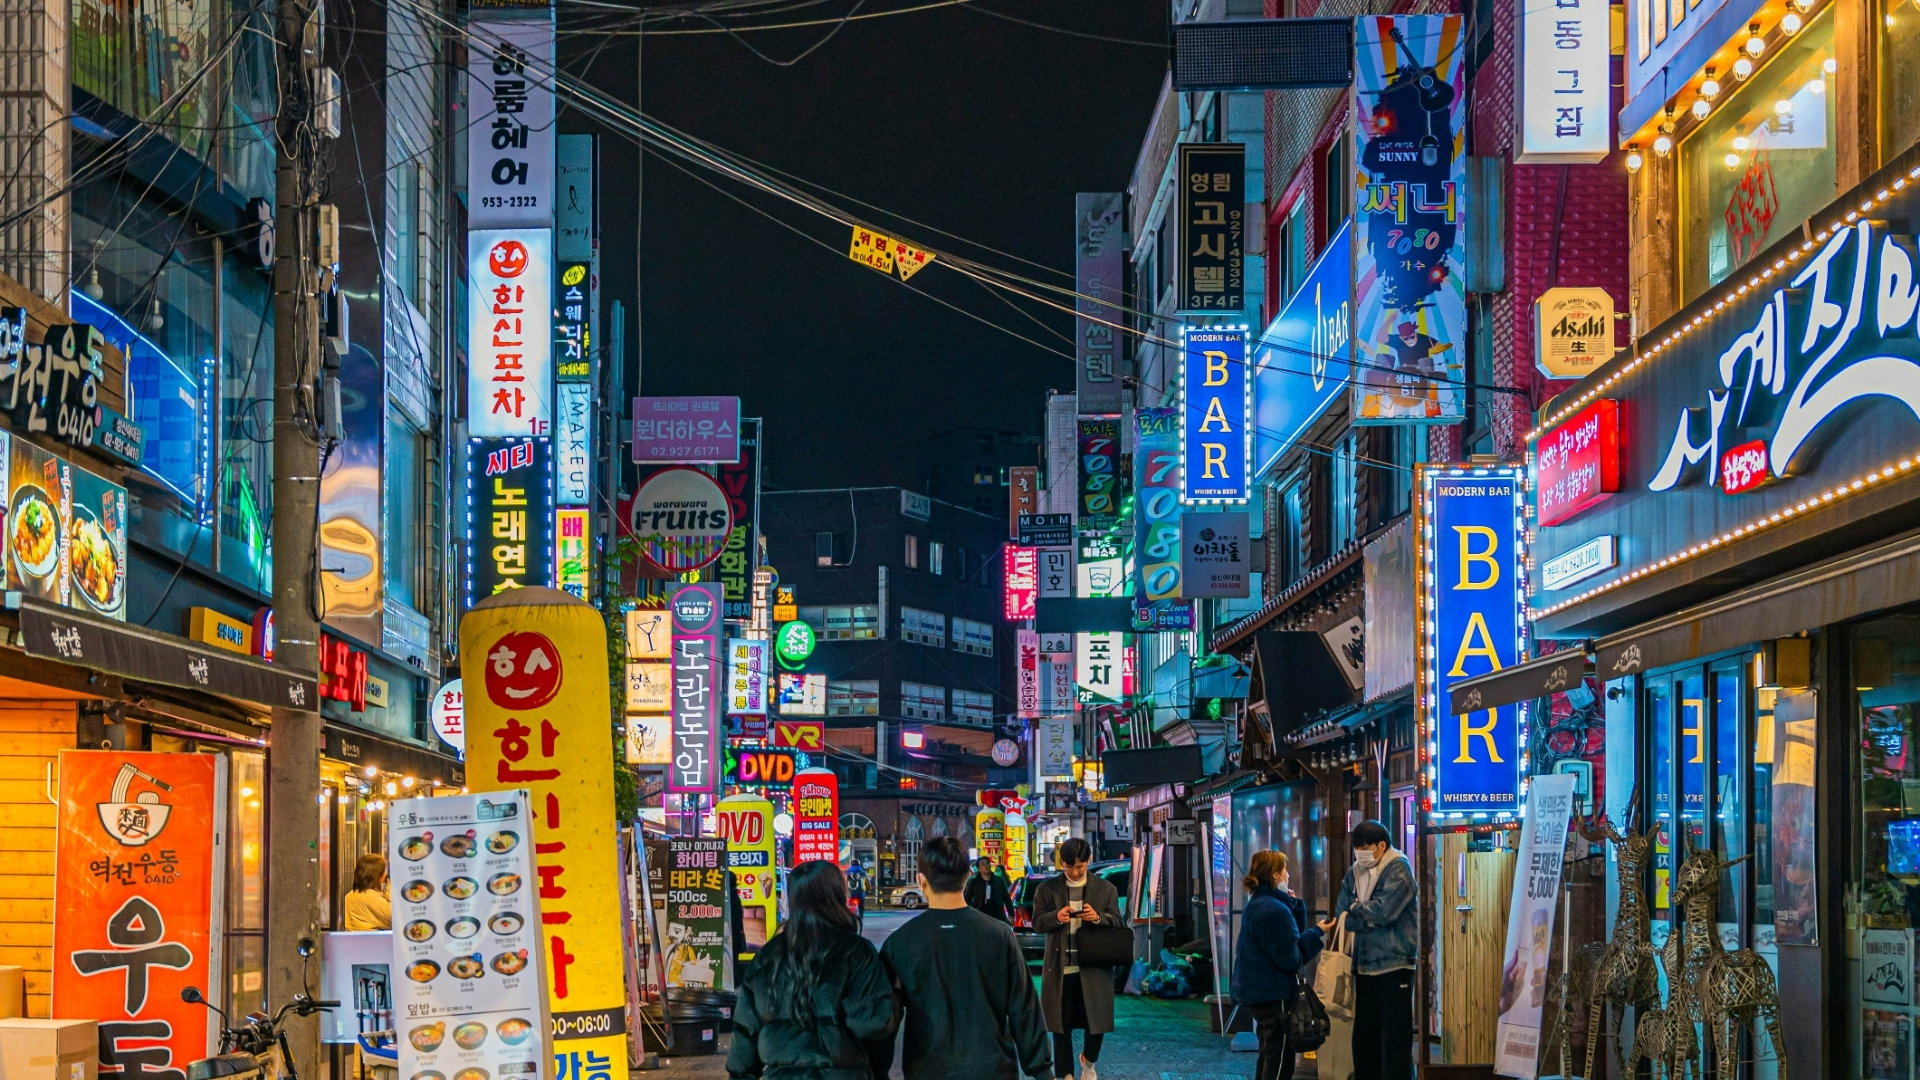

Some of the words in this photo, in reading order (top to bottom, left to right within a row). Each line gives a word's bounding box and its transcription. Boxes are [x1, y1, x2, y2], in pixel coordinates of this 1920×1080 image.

[1379, 152, 1418, 162] SUNNY
[1191, 173, 1231, 193] 영림
[482, 196, 537, 207] 953-2322
[1362, 181, 1457, 224] 써니
[1192, 201, 1226, 292] 고시텔
[1387, 229, 1440, 255] 7080
[565, 286, 583, 359] 스웨디시
[1328, 300, 1349, 360] BAR
[1551, 315, 1605, 337] Asahi
[1190, 334, 1223, 342] MODERN
[1225, 334, 1241, 342] BAR
[1571, 341, 1586, 352] 生
[492, 284, 526, 418] 한신포차
[1401, 385, 1416, 396] B1
[57, 402, 94, 447] 0410
[1198, 350, 1233, 479] BAR
[528, 417, 549, 435] 1F
[637, 419, 734, 440] 원더하우스
[486, 442, 534, 476] 시티
[651, 446, 719, 456] 02.927.6171
[1086, 439, 1113, 511] 7080
[1439, 486, 1485, 496] MODERN
[1489, 486, 1511, 496] BAR
[653, 501, 708, 509] warawara
[635, 509, 727, 530] Fruits
[1146, 456, 1180, 595] 7080
[1021, 535, 1031, 544] 4F
[720, 522, 752, 600] 영화관
[1193, 542, 1241, 562] 이차돌
[1017, 550, 1034, 589] BAR
[778, 593, 793, 604] 24
[1046, 640, 1066, 651] 2층
[1447, 526, 1504, 763] BAR
[735, 645, 749, 710] 세계주류
[748, 645, 763, 710] 아이스크림
[1080, 691, 1094, 702] 2F
[674, 639, 710, 786] 도란돈암
[779, 724, 820, 748] VR
[740, 752, 794, 782] DVD
[800, 783, 832, 798] 24hour
[1443, 793, 1480, 802] WHISKY
[1490, 793, 1514, 802] BEER
[799, 797, 832, 818] 무인마켓
[398, 812, 418, 825] 우동
[718, 811, 764, 845] DVD
[801, 822, 813, 830] BIG
[813, 821, 831, 830] SALE
[1534, 821, 1563, 845] 참이슬
[670, 842, 692, 851] 코로나
[694, 841, 725, 851] 이겨내자
[89, 849, 179, 887] 역전우동
[676, 851, 718, 868] 화이팅
[728, 851, 764, 866] 동의자
[1531, 852, 1561, 876] 무제한
[144, 874, 175, 885] 0410
[670, 870, 702, 889] 테라
[669, 890, 707, 902] 500cc
[408, 1003, 430, 1016] 덮밥
